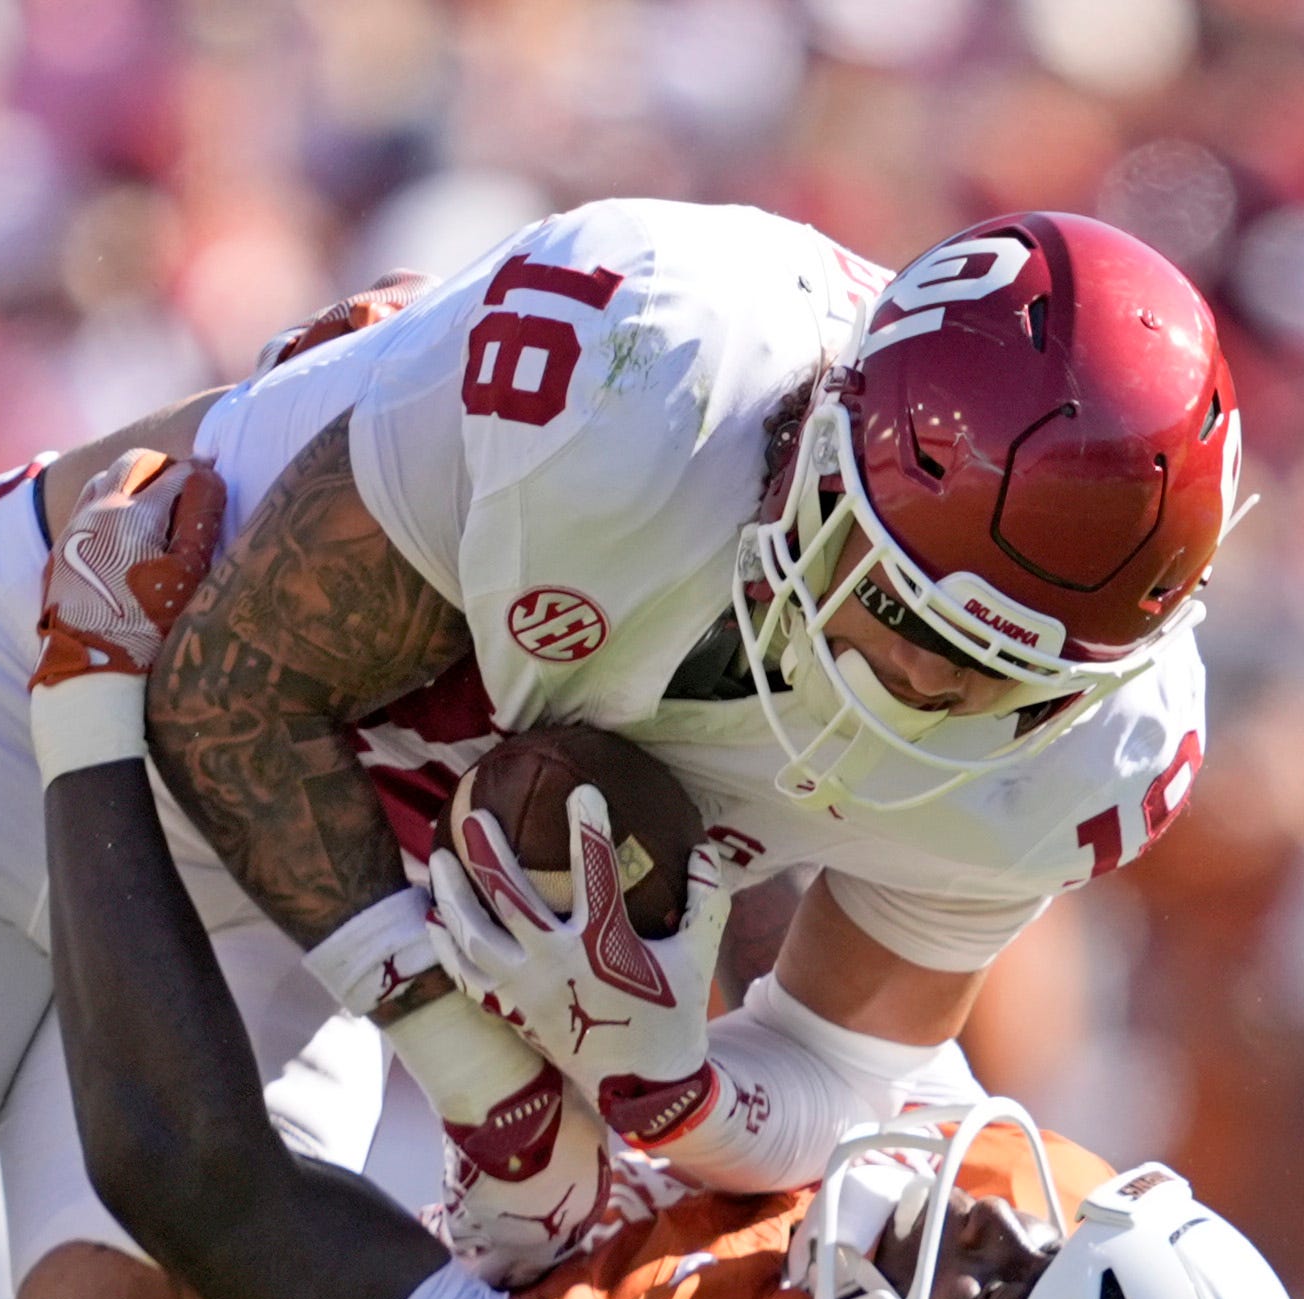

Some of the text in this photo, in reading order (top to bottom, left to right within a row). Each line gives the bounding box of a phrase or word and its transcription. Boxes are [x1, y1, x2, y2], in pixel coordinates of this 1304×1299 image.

[462, 253, 625, 427] 18
[509, 590, 606, 661] SEC
[963, 598, 1040, 648] OKLAHOMA
